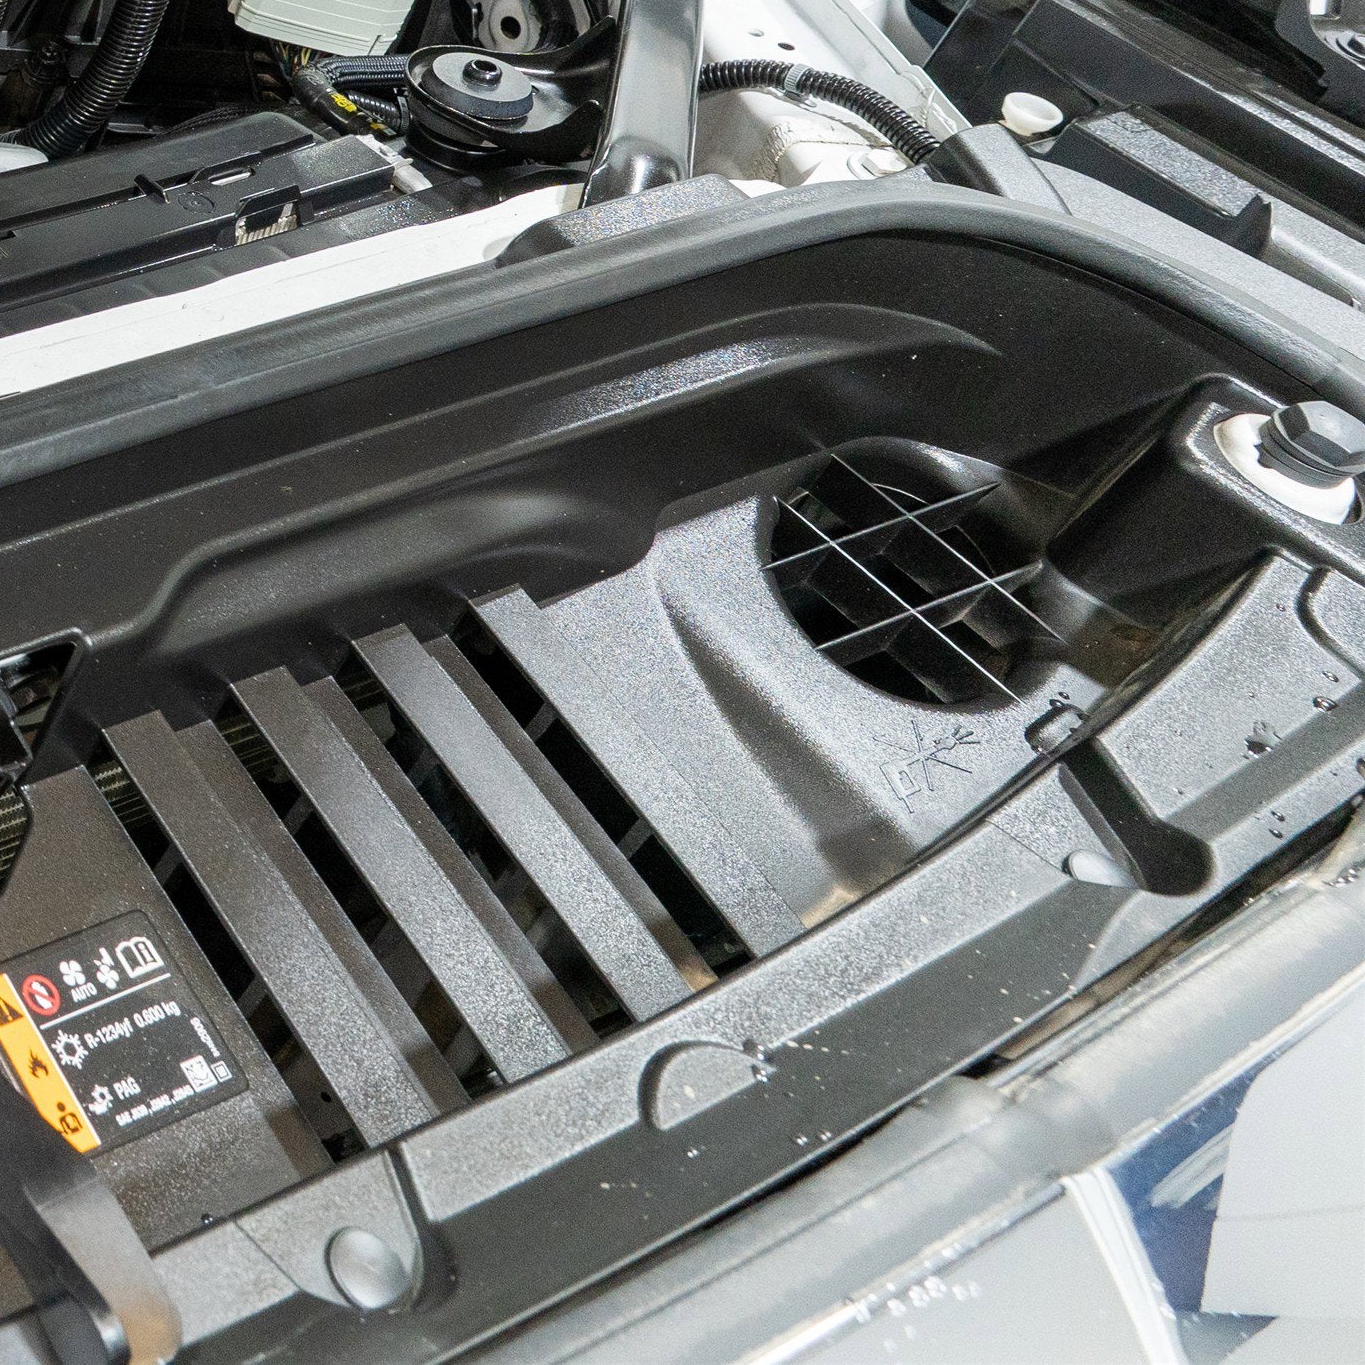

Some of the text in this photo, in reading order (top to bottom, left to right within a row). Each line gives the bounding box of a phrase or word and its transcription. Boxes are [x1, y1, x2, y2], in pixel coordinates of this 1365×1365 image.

[71, 982, 98, 1003] AUTO
[84, 1001, 181, 1049] R-1234yf 0.600 kg
[113, 1076, 141, 1100] PAG
